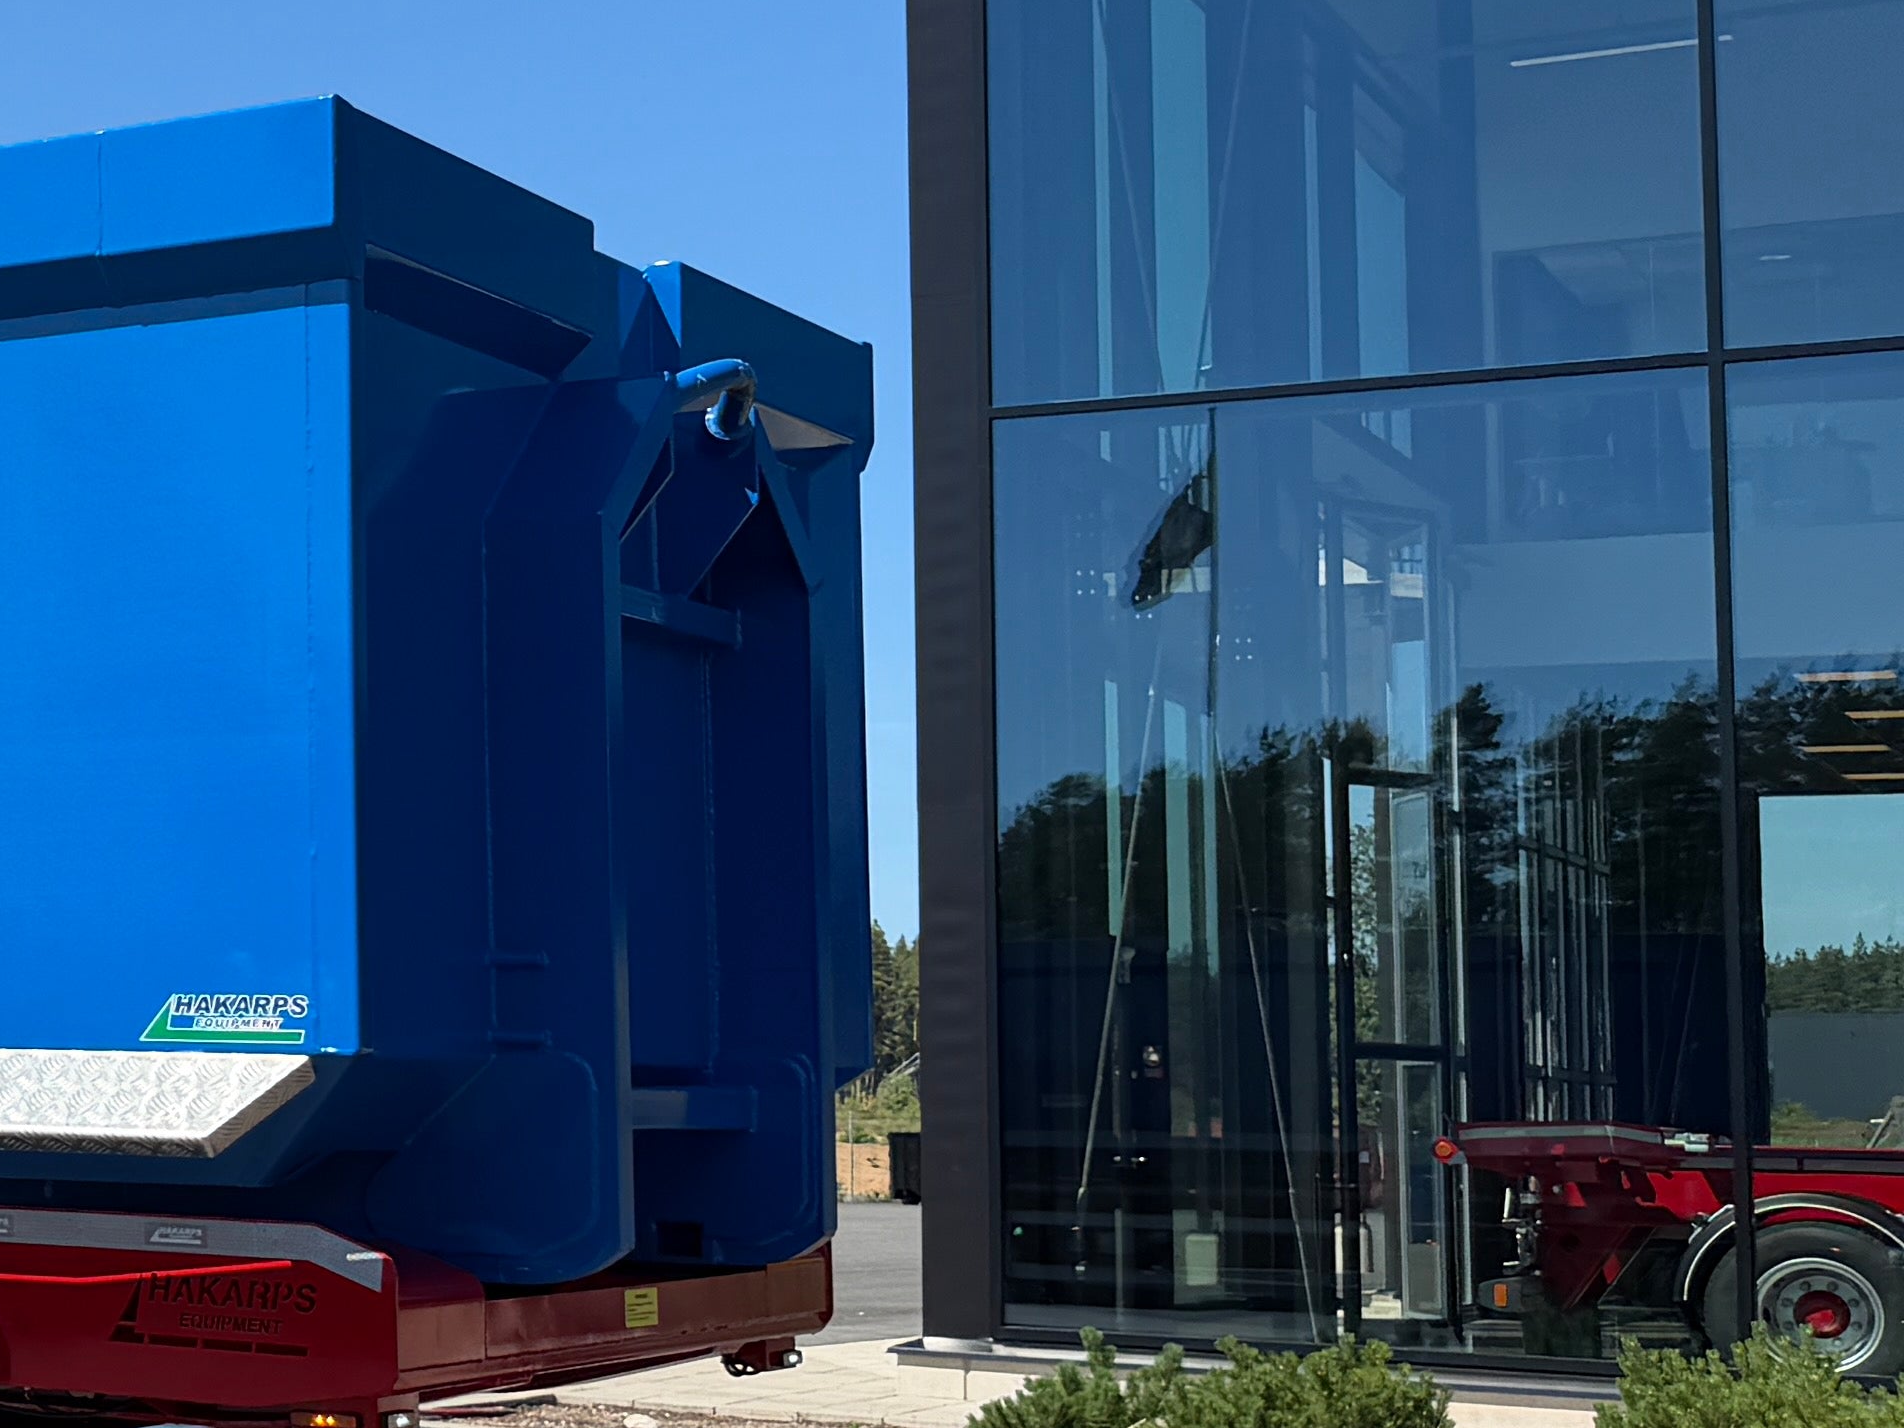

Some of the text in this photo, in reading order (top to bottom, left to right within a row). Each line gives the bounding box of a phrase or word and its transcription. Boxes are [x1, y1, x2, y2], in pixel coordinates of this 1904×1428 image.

[172, 994, 310, 1018] HAKARPS
[194, 1017, 284, 1029] EQUIPMENT
[148, 1272, 318, 1314] HAKARPS
[179, 1314, 283, 1335] EQUIPMENT
